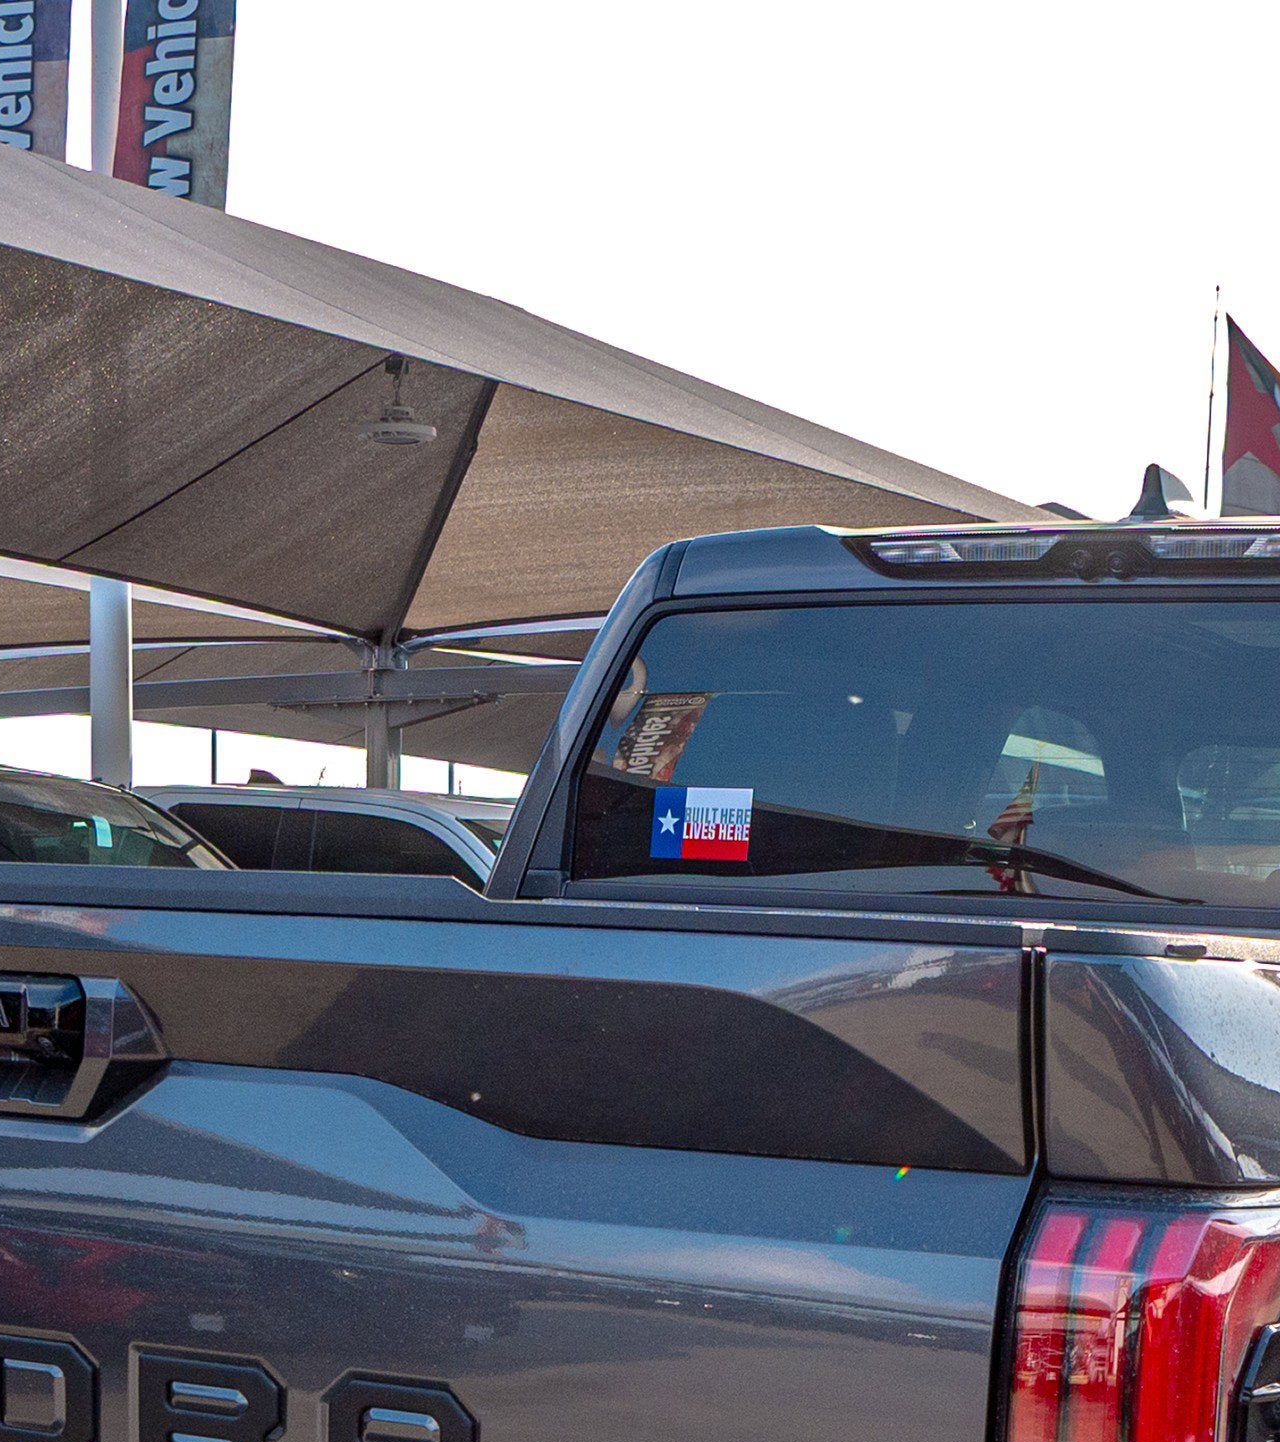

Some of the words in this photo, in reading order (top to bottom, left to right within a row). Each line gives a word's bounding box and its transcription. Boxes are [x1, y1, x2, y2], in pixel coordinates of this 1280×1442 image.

[685, 807, 719, 824] BUILT
[720, 807, 751, 824] HERE
[682, 822, 716, 840] LIVES
[718, 823, 751, 841] HERE
